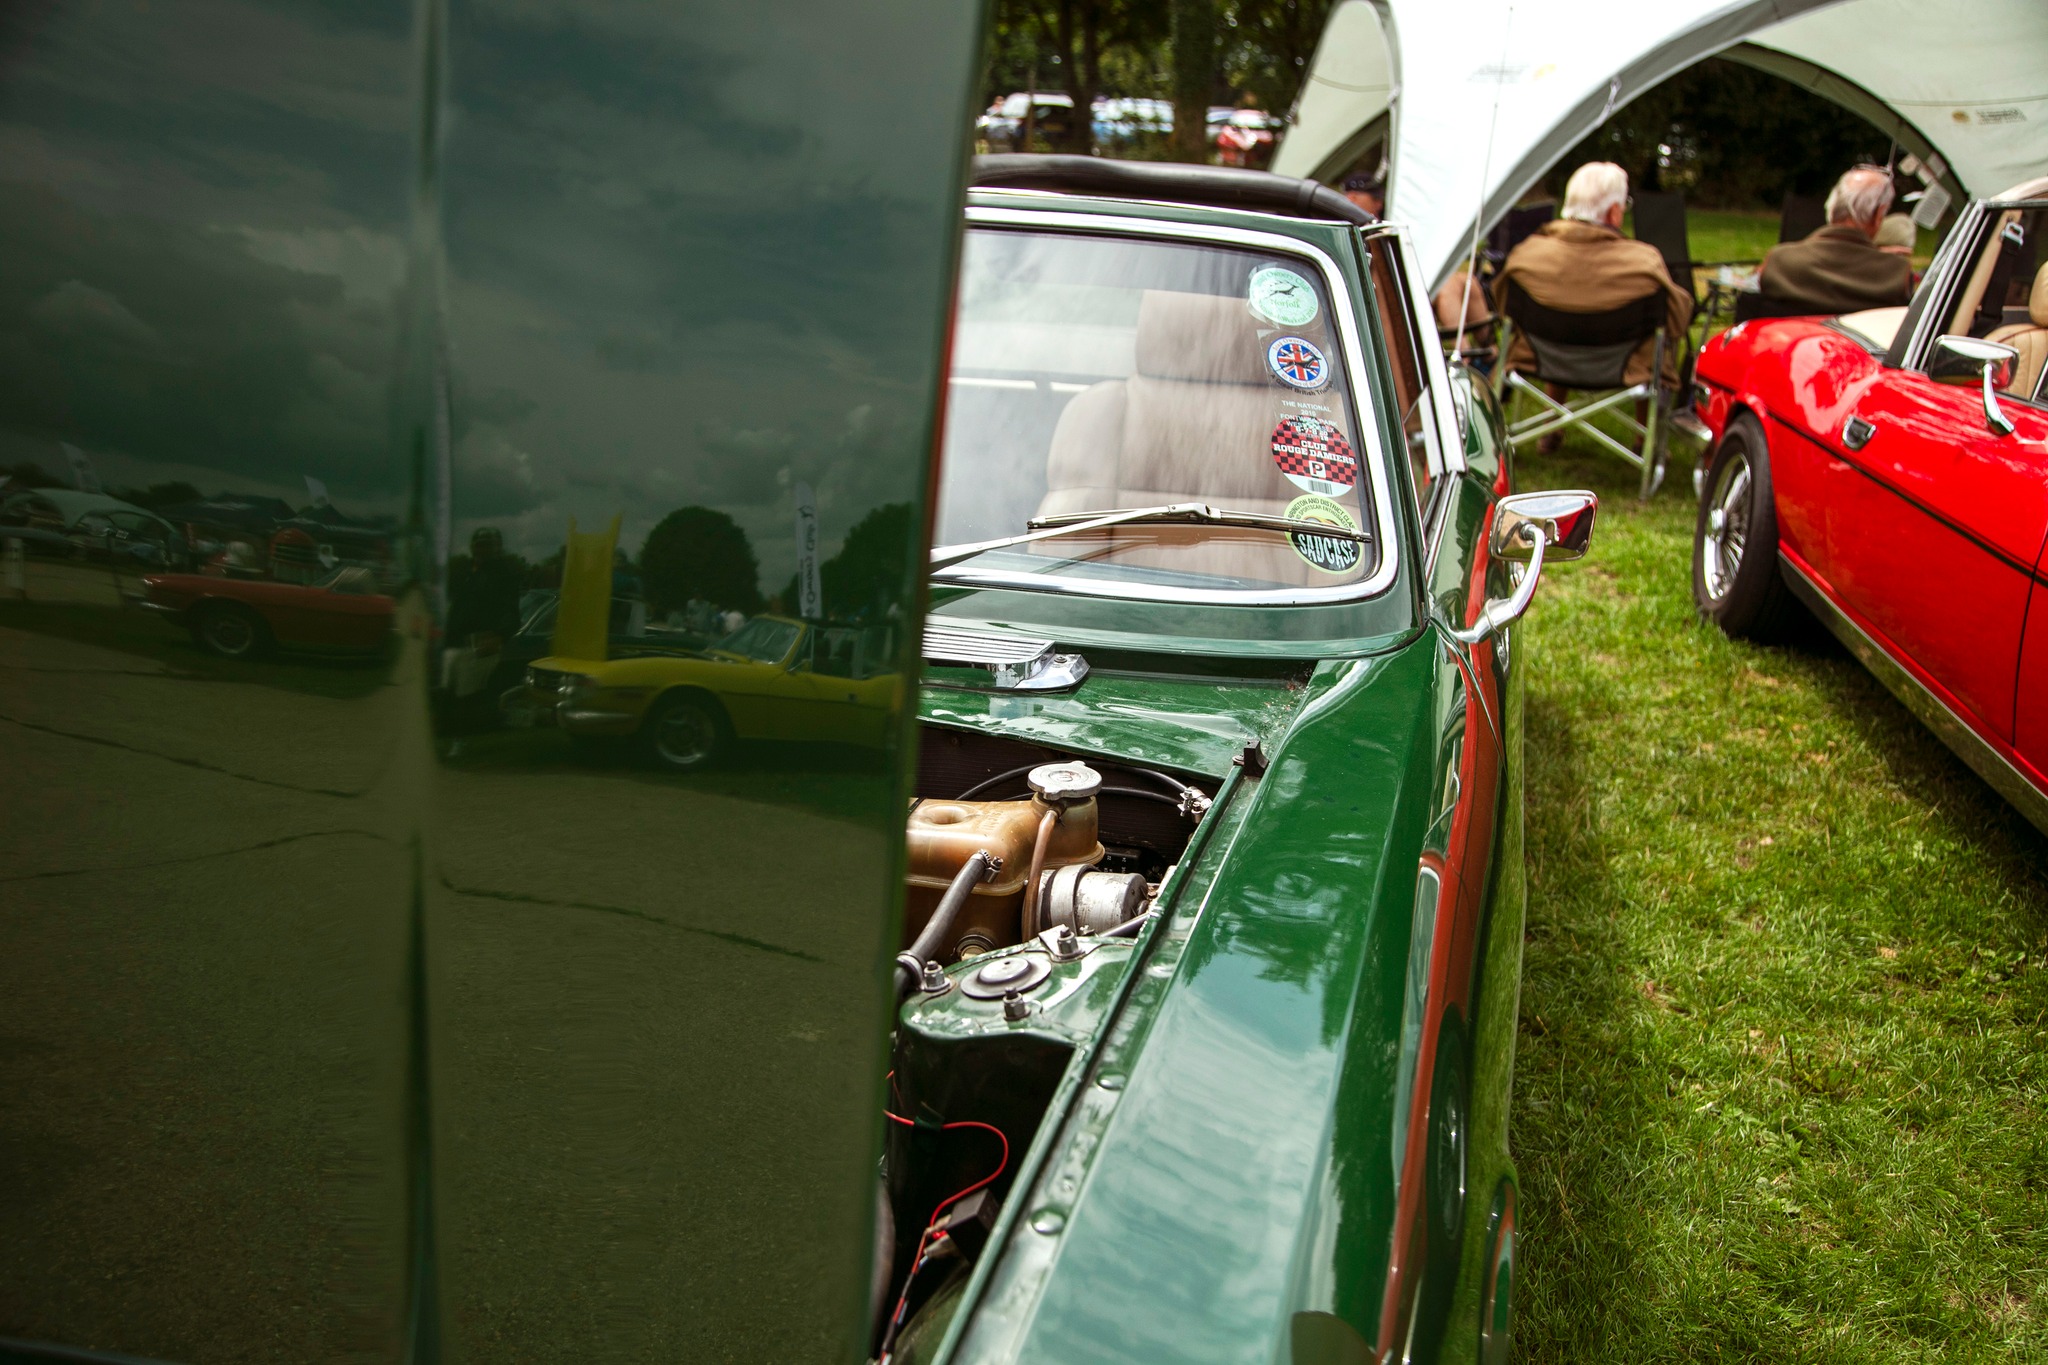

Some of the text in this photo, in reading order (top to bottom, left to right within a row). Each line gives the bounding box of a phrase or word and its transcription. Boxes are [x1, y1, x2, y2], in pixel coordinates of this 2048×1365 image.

[1294, 388, 1316, 396] British
[1281, 400, 1332, 413] THE NATIONAL
[1301, 440, 1327, 451] CLUB
[1273, 443, 1355, 465] ROUGE DAMIERS
[1311, 462, 1323, 475] P
[1307, 497, 1320, 505] AND
[1320, 499, 1344, 515] DISTRICT
[1297, 533, 1356, 569] SADCASE
